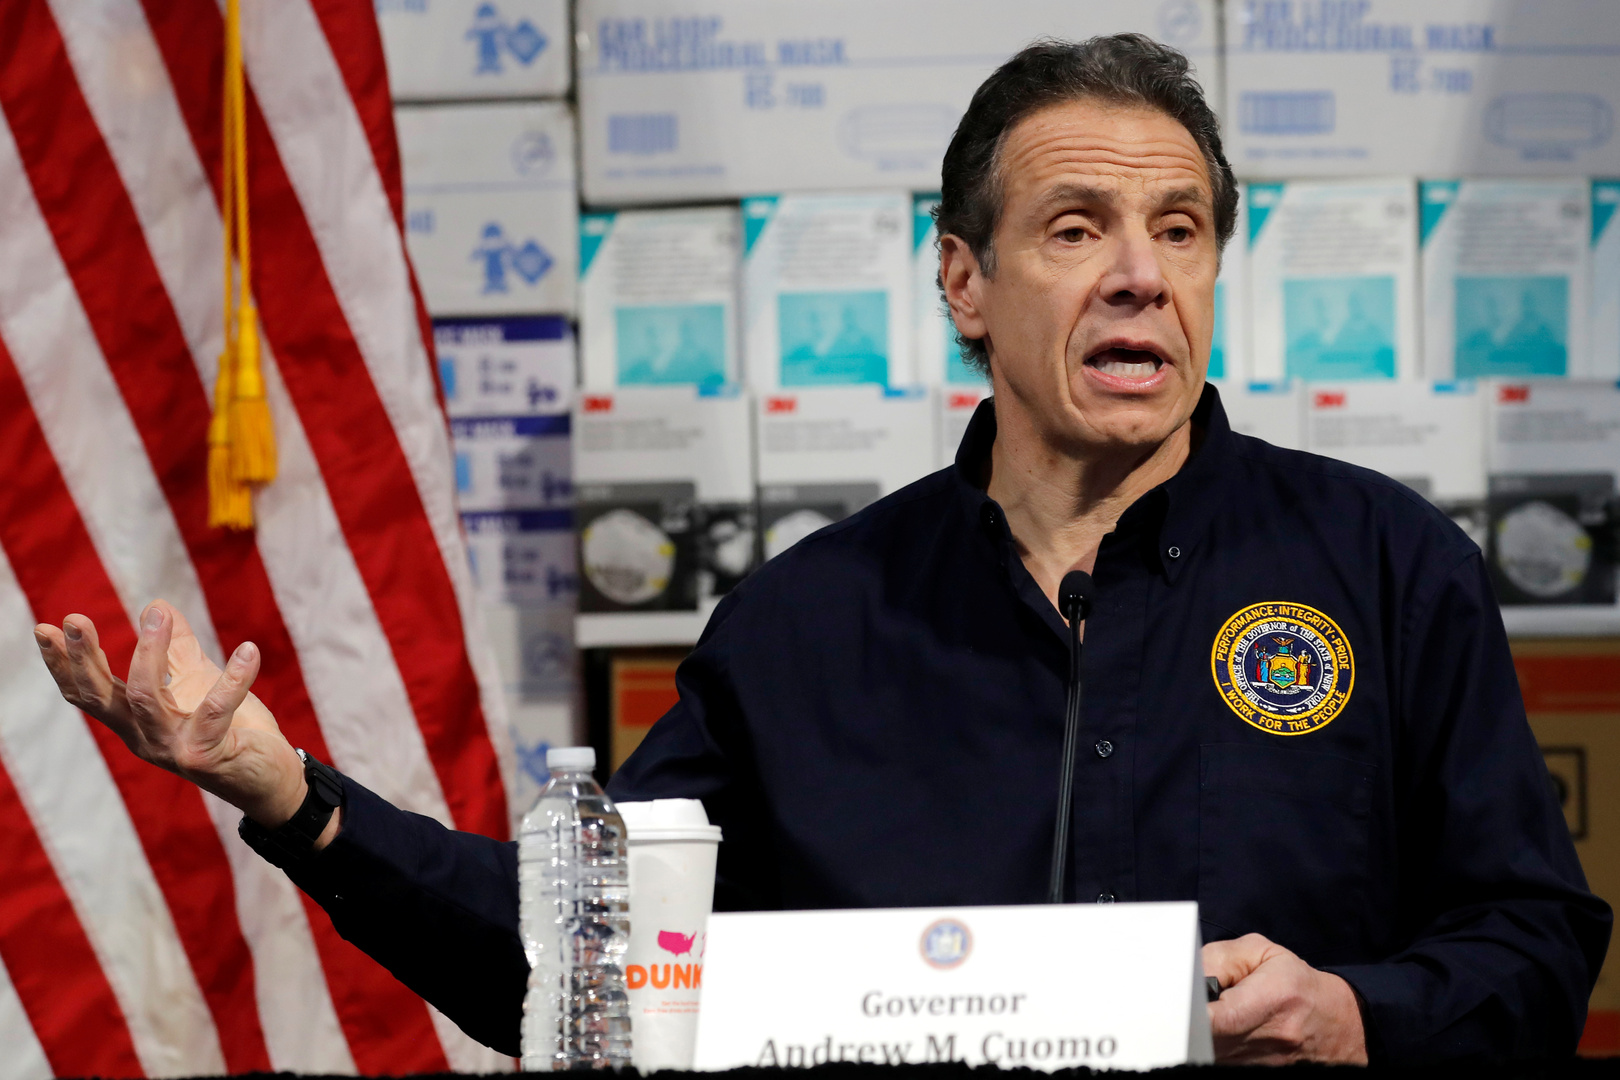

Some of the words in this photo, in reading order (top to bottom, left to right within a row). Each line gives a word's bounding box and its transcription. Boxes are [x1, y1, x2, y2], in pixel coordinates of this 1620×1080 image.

[1217, 606, 1274, 661] PERFORMANCE
[1279, 606, 1336, 636] INTEGRITY
[1332, 637, 1349, 670] PRIDE
[1247, 621, 1287, 639] GOVERNOR
[1227, 689, 1257, 720] WORK
[1259, 716, 1282, 731] FOR
[1287, 719, 1311, 731] THE
[1312, 690, 1346, 725] PEOPLE
[861, 990, 1028, 1019] Governor
[757, 1035, 914, 1067] Andrew
[981, 1031, 1119, 1064] Cuomo
